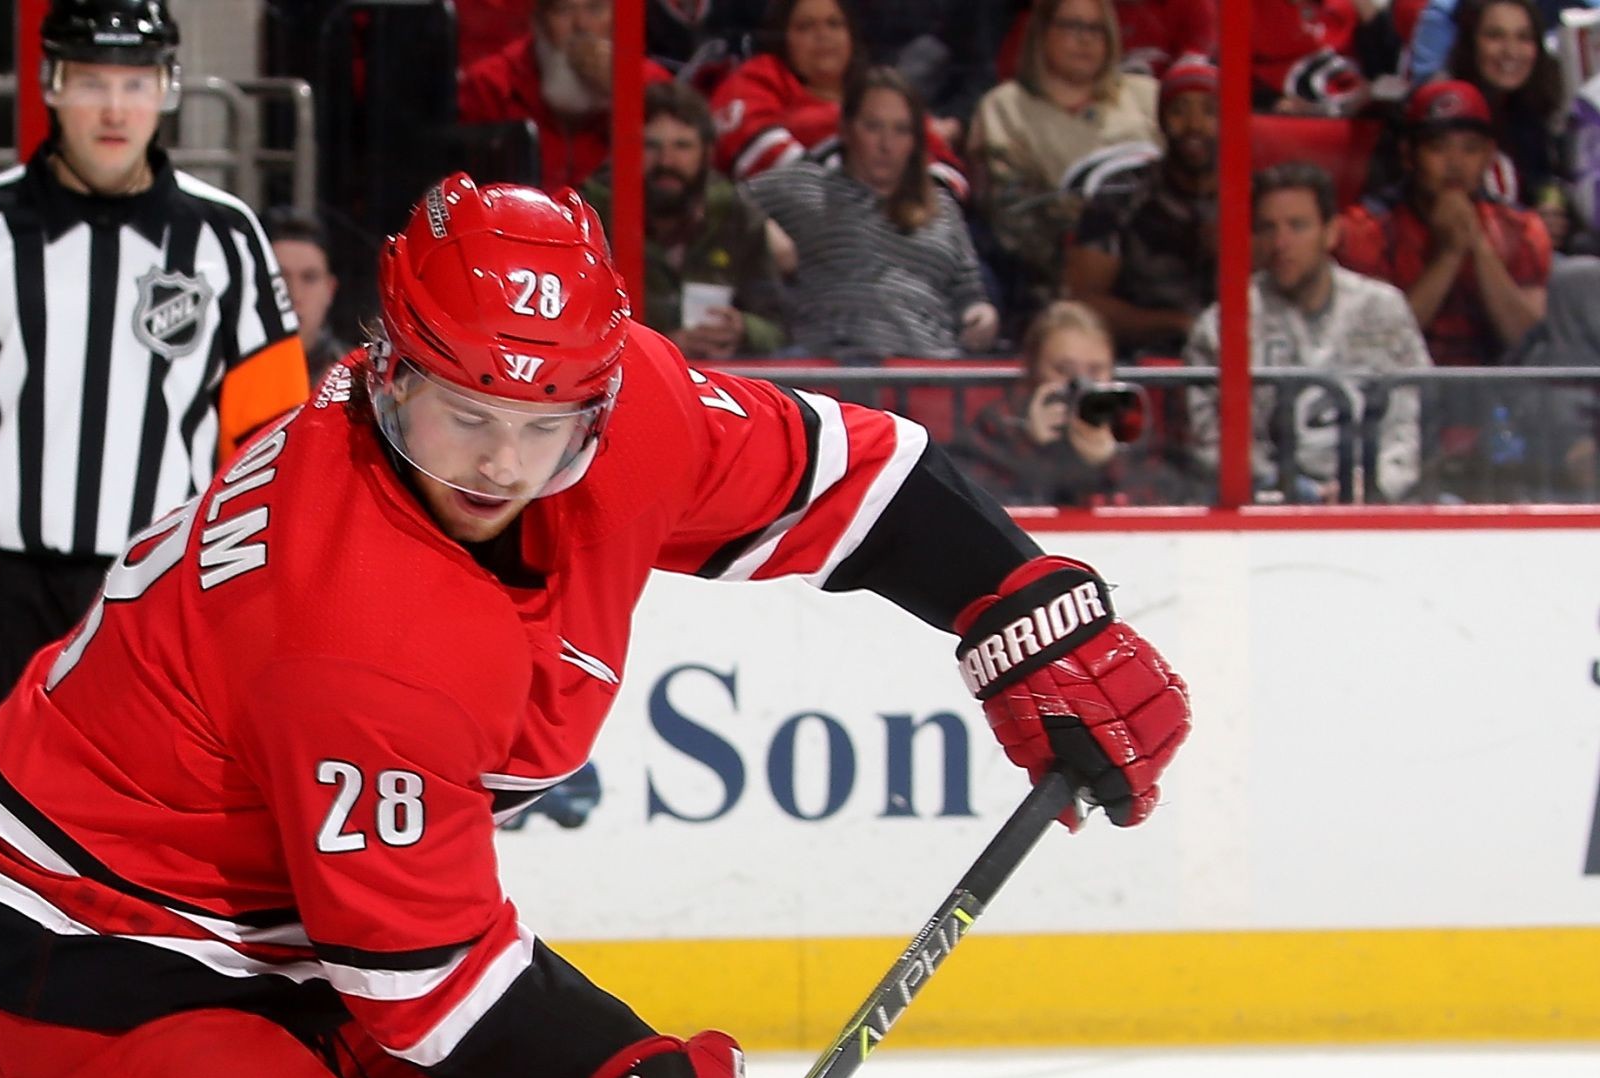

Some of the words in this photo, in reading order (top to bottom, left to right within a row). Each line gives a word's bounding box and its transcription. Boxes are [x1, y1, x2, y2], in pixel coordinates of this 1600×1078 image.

[150, 288, 197, 336] NHL
[506, 268, 562, 319] 28
[646, 662, 982, 824] Son
[316, 758, 425, 854] 28
[860, 907, 975, 1064] ALPHA
